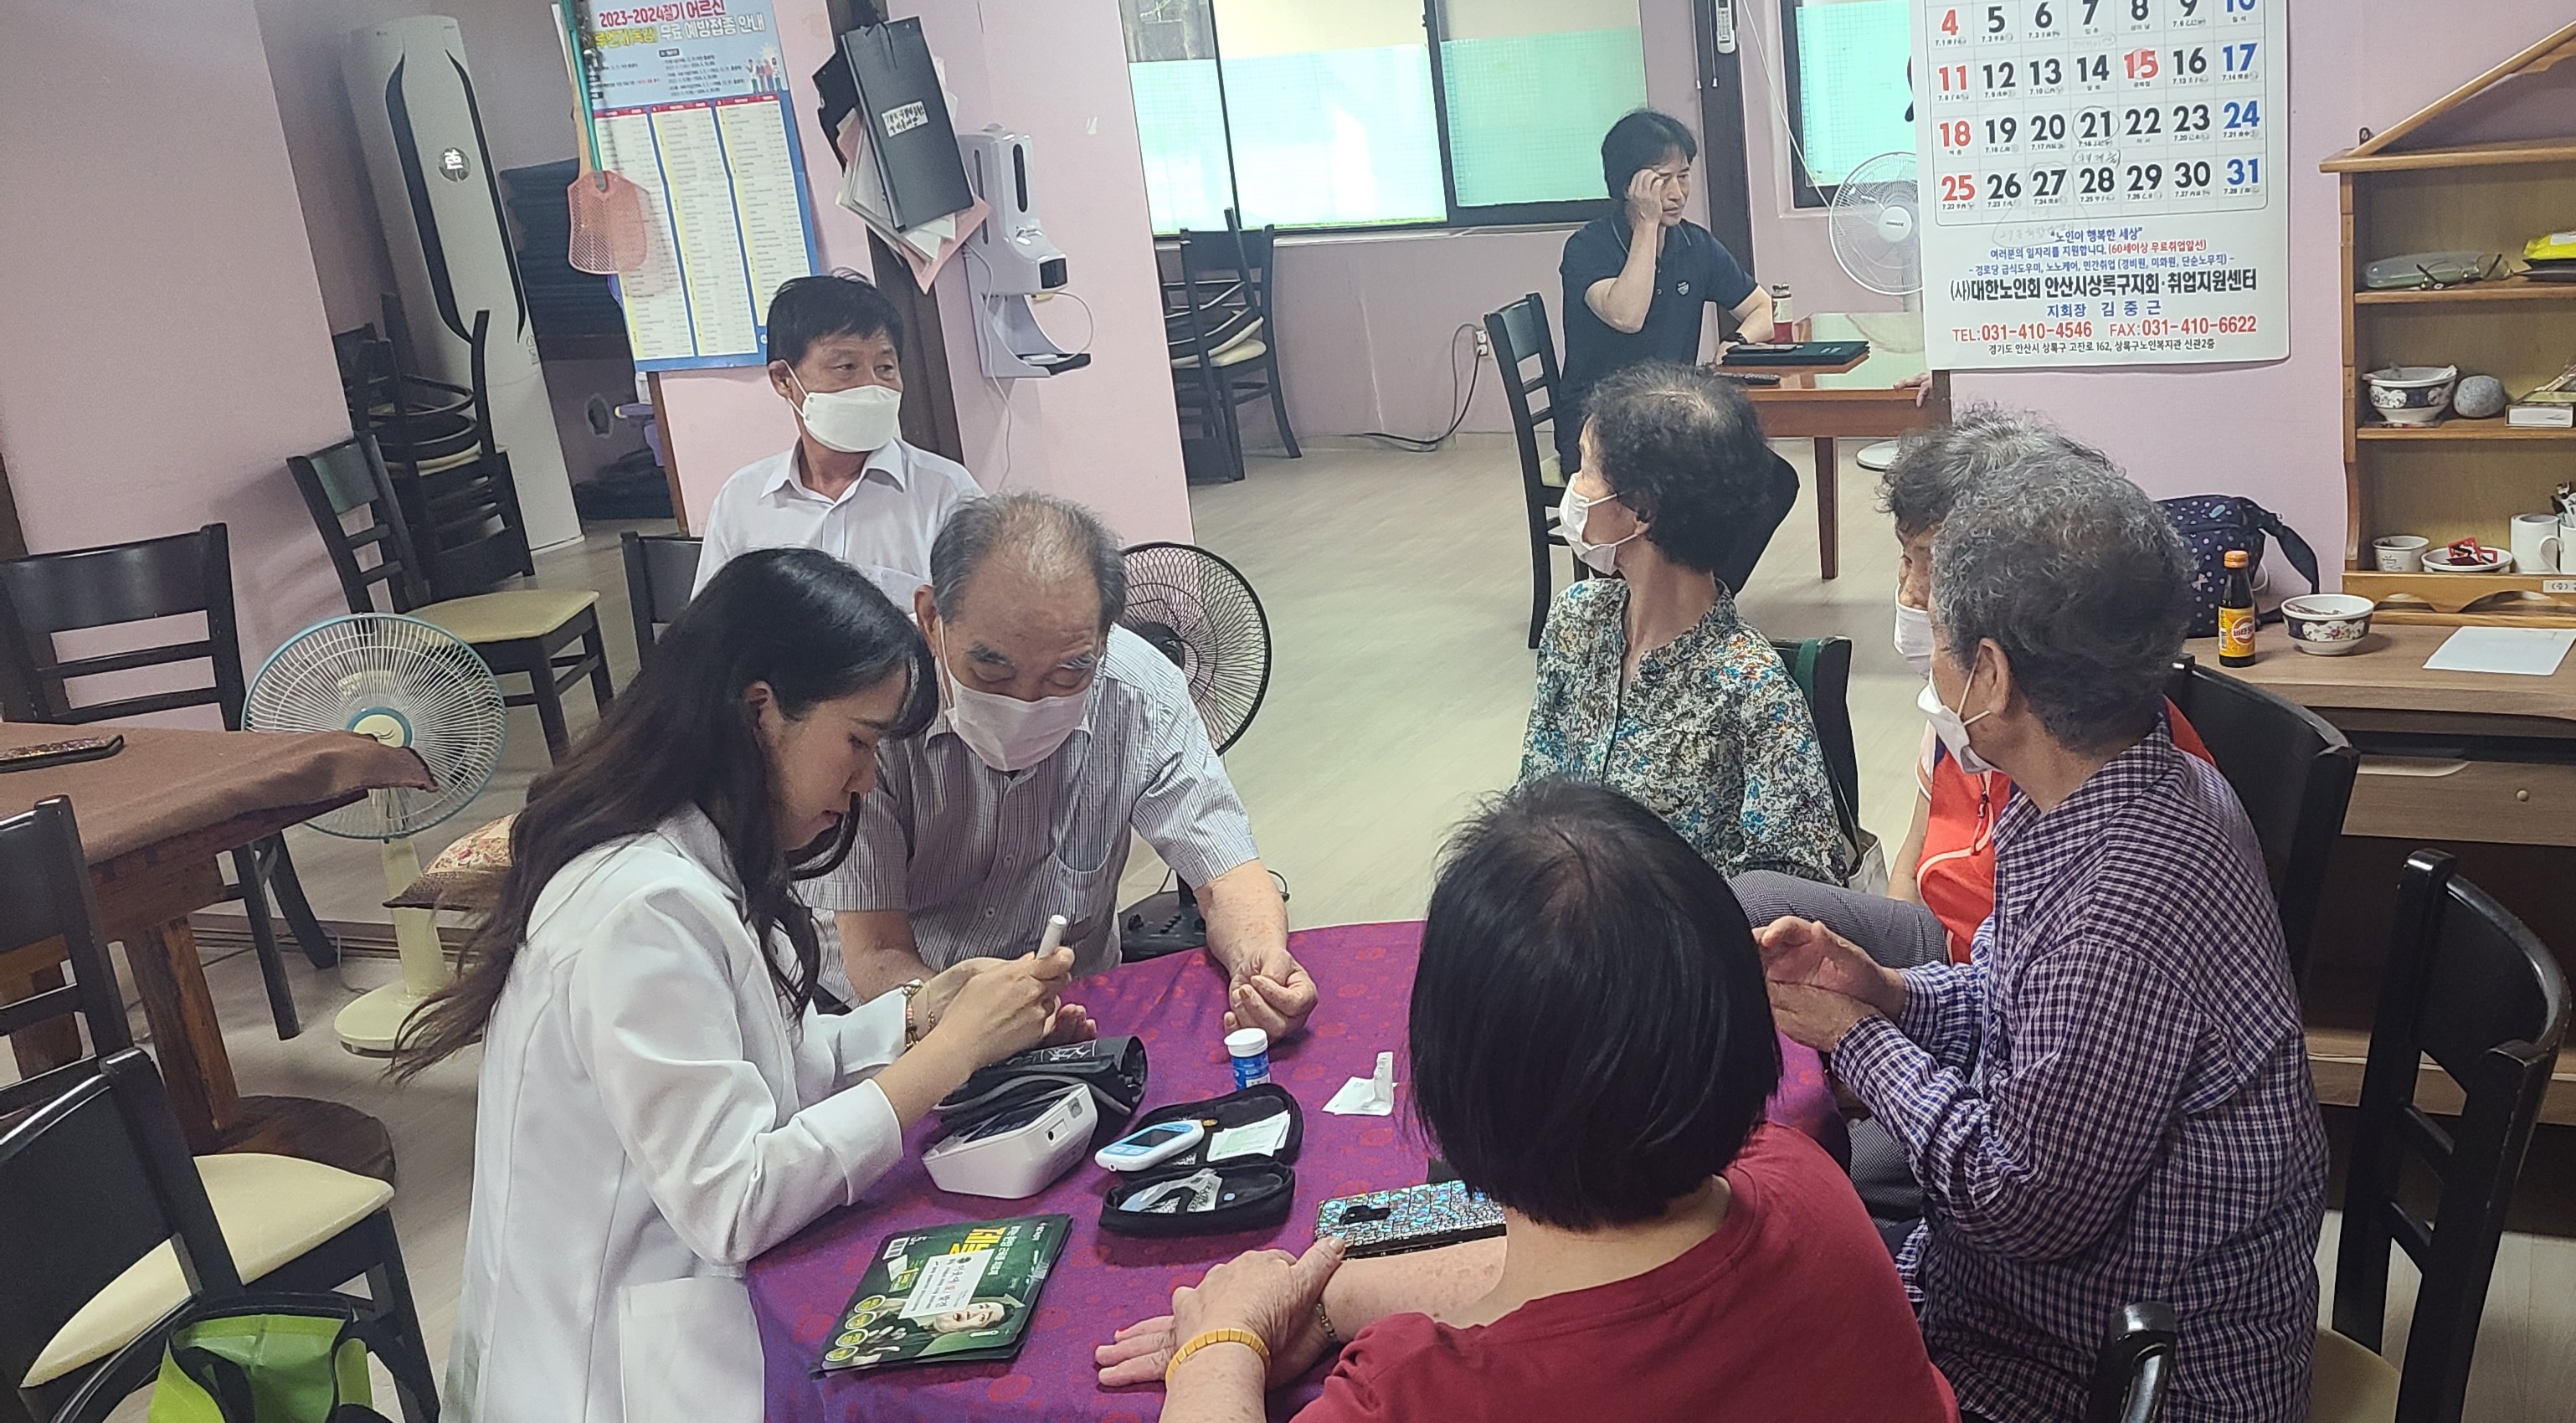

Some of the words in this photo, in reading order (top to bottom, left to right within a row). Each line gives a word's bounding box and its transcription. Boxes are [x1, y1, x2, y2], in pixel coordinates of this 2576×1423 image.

[599, 3, 686, 28] 2023-2024절기
[686, 0, 726, 18] 어르신
[661, 23, 682, 39] 무료
[685, 17, 737, 39] 예방접종
[738, 13, 765, 32] 안내
[1941, 9, 1959, 36] 4
[1987, 5, 2006, 33] 5
[2034, 2, 2053, 28] 6
[2082, 0, 2100, 25] 7
[2131, 0, 2149, 21] 8
[2180, 0, 2198, 18] 9
[1938, 64, 1967, 91] 11
[1982, 61, 2016, 89] 12
[2029, 58, 2062, 85] 13
[2076, 54, 2110, 83] 14
[2124, 49, 2159, 79] 15
[2173, 46, 2207, 75] 16
[2222, 43, 2259, 72] 17
[1939, 120, 1972, 147] 18
[1985, 116, 2017, 144] 19
[2030, 114, 2065, 141] 20
[2080, 110, 2111, 138] 21
[2125, 107, 2162, 136] 22
[2172, 104, 2210, 132] 23
[2224, 100, 2260, 129] 24
[1941, 174, 1976, 202] 25
[1987, 172, 2022, 200] 26
[2033, 169, 2068, 198] 27
[2080, 167, 2115, 193] 28
[2126, 164, 2162, 192] 29
[2174, 161, 2211, 188] 30
[2226, 157, 2259, 185] 31
[2086, 229, 2116, 242] 행복한
[1990, 246, 2023, 259] 여러분의
[2026, 245, 2059, 259] 일자리를
[2062, 244, 2107, 257] 지원합니다.
[2108, 241, 2149, 254] (60세이상
[1975, 265, 1998, 276] 경로당
[2002, 262, 2044, 275] 급식도우미,
[2083, 259, 2116, 271] 민간취업
[1950, 277, 2041, 301] (사)대한노인회
[2047, 303, 2086, 318] 지회장
[1988, 343, 2013, 355] 경기도
[2015, 342, 2039, 354] 안산시
[2042, 342, 2067, 353] 상록구
[2069, 341, 2094, 352] 고잔로
[2115, 338, 2181, 352] 상록구노인복지관
